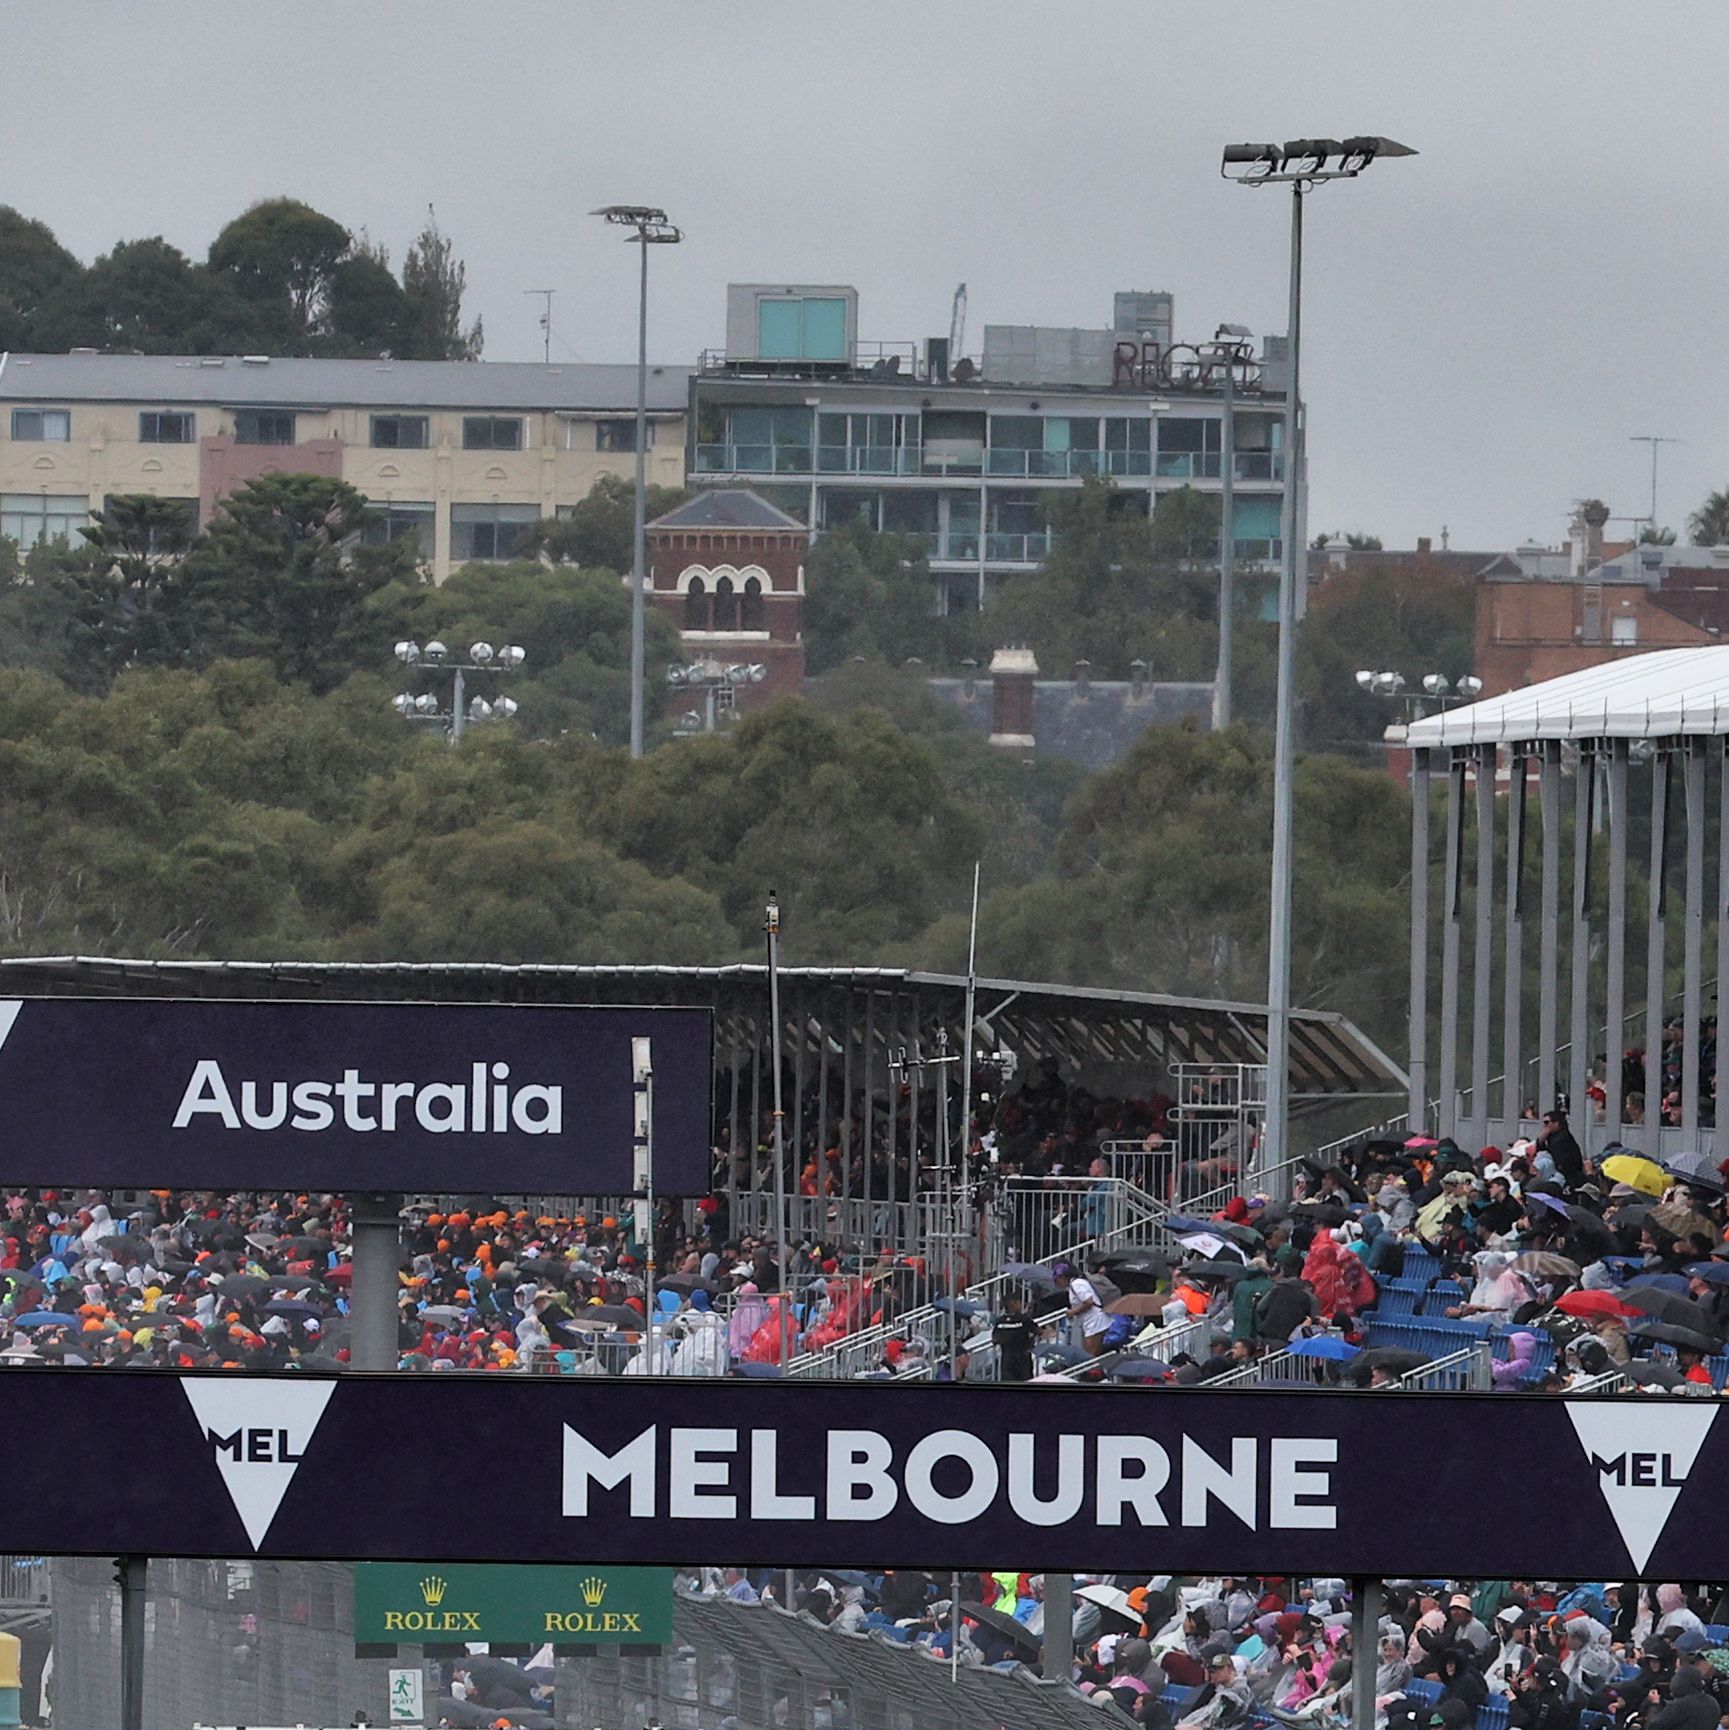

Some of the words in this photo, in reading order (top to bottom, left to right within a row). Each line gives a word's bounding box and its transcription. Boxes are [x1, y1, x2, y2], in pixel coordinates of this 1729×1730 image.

[172, 1060, 562, 1134] Australia
[208, 1428, 302, 1464] MEL
[562, 1423, 1338, 1531] MELBOURNE
[1591, 1451, 1687, 1488] MEL
[384, 1611, 481, 1631] ROLEX
[544, 1612, 641, 1632] ROLEX
